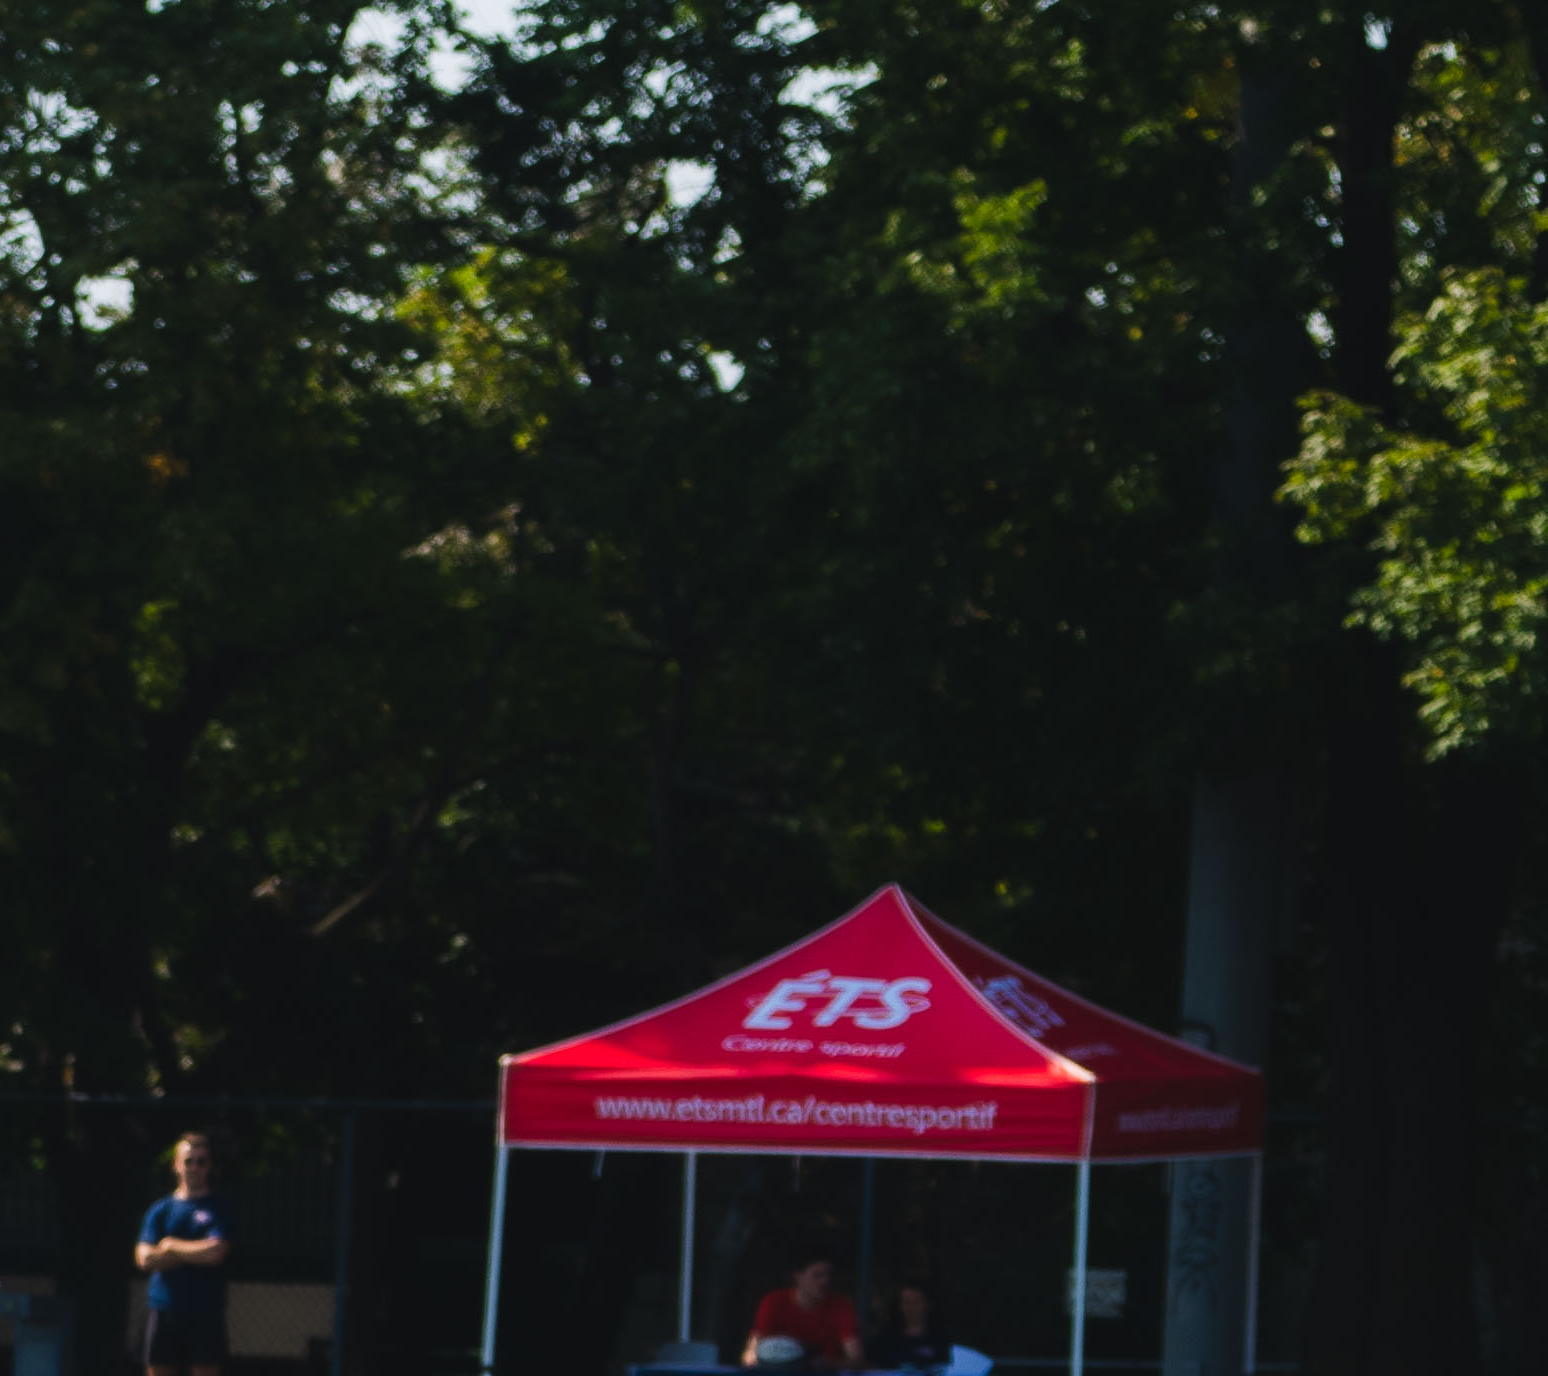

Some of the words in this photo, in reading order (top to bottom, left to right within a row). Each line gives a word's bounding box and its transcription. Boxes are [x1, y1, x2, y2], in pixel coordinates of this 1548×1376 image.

[743, 970, 932, 1030] ÉTS
[721, 1035, 814, 1053] Centre
[595, 1094, 998, 1135] www.etsmtl.ca/centresportif
